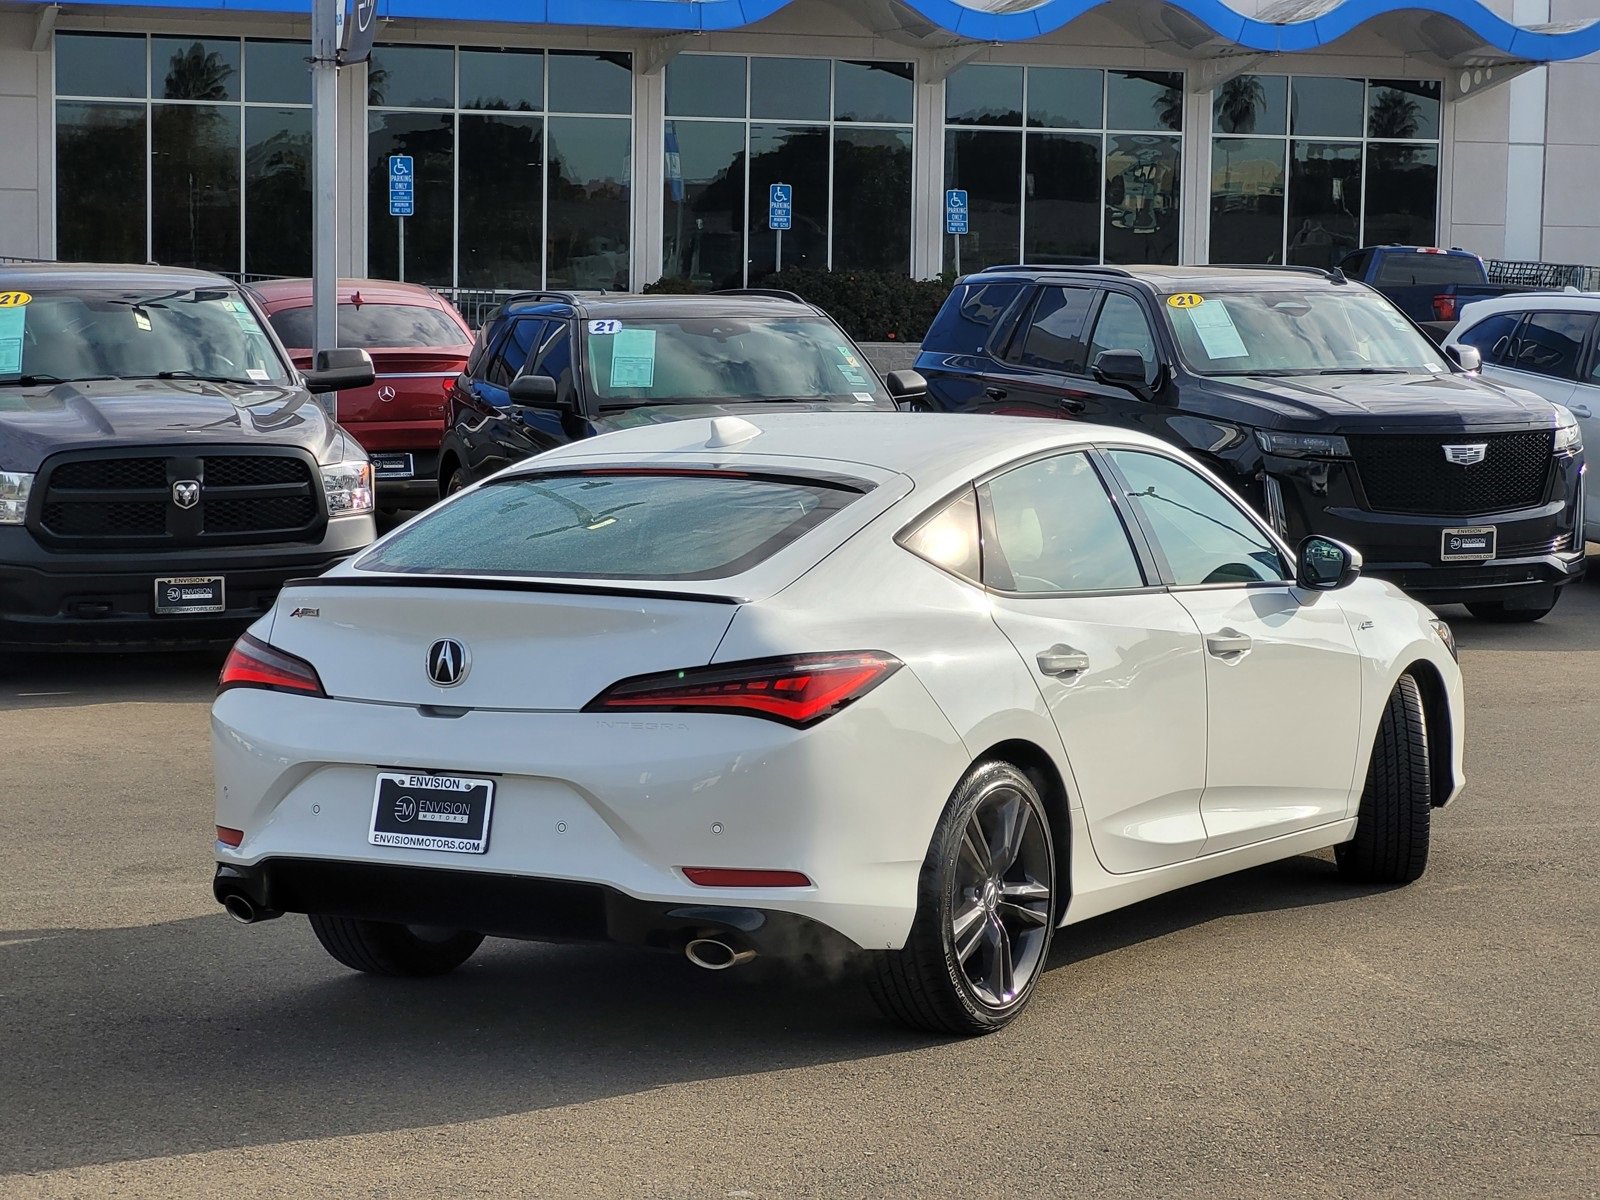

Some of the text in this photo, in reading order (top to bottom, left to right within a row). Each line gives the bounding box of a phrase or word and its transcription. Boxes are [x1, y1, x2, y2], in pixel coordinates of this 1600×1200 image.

[0, 294, 21, 304] 21
[1176, 295, 1194, 306] 21
[594, 322, 614, 332] 21
[595, 721, 690, 730] INTEGRA
[409, 776, 460, 790] ENVISION
[419, 800, 470, 814] ENVISION
[374, 834, 480, 852] ENVISIONMOTORS.COM
